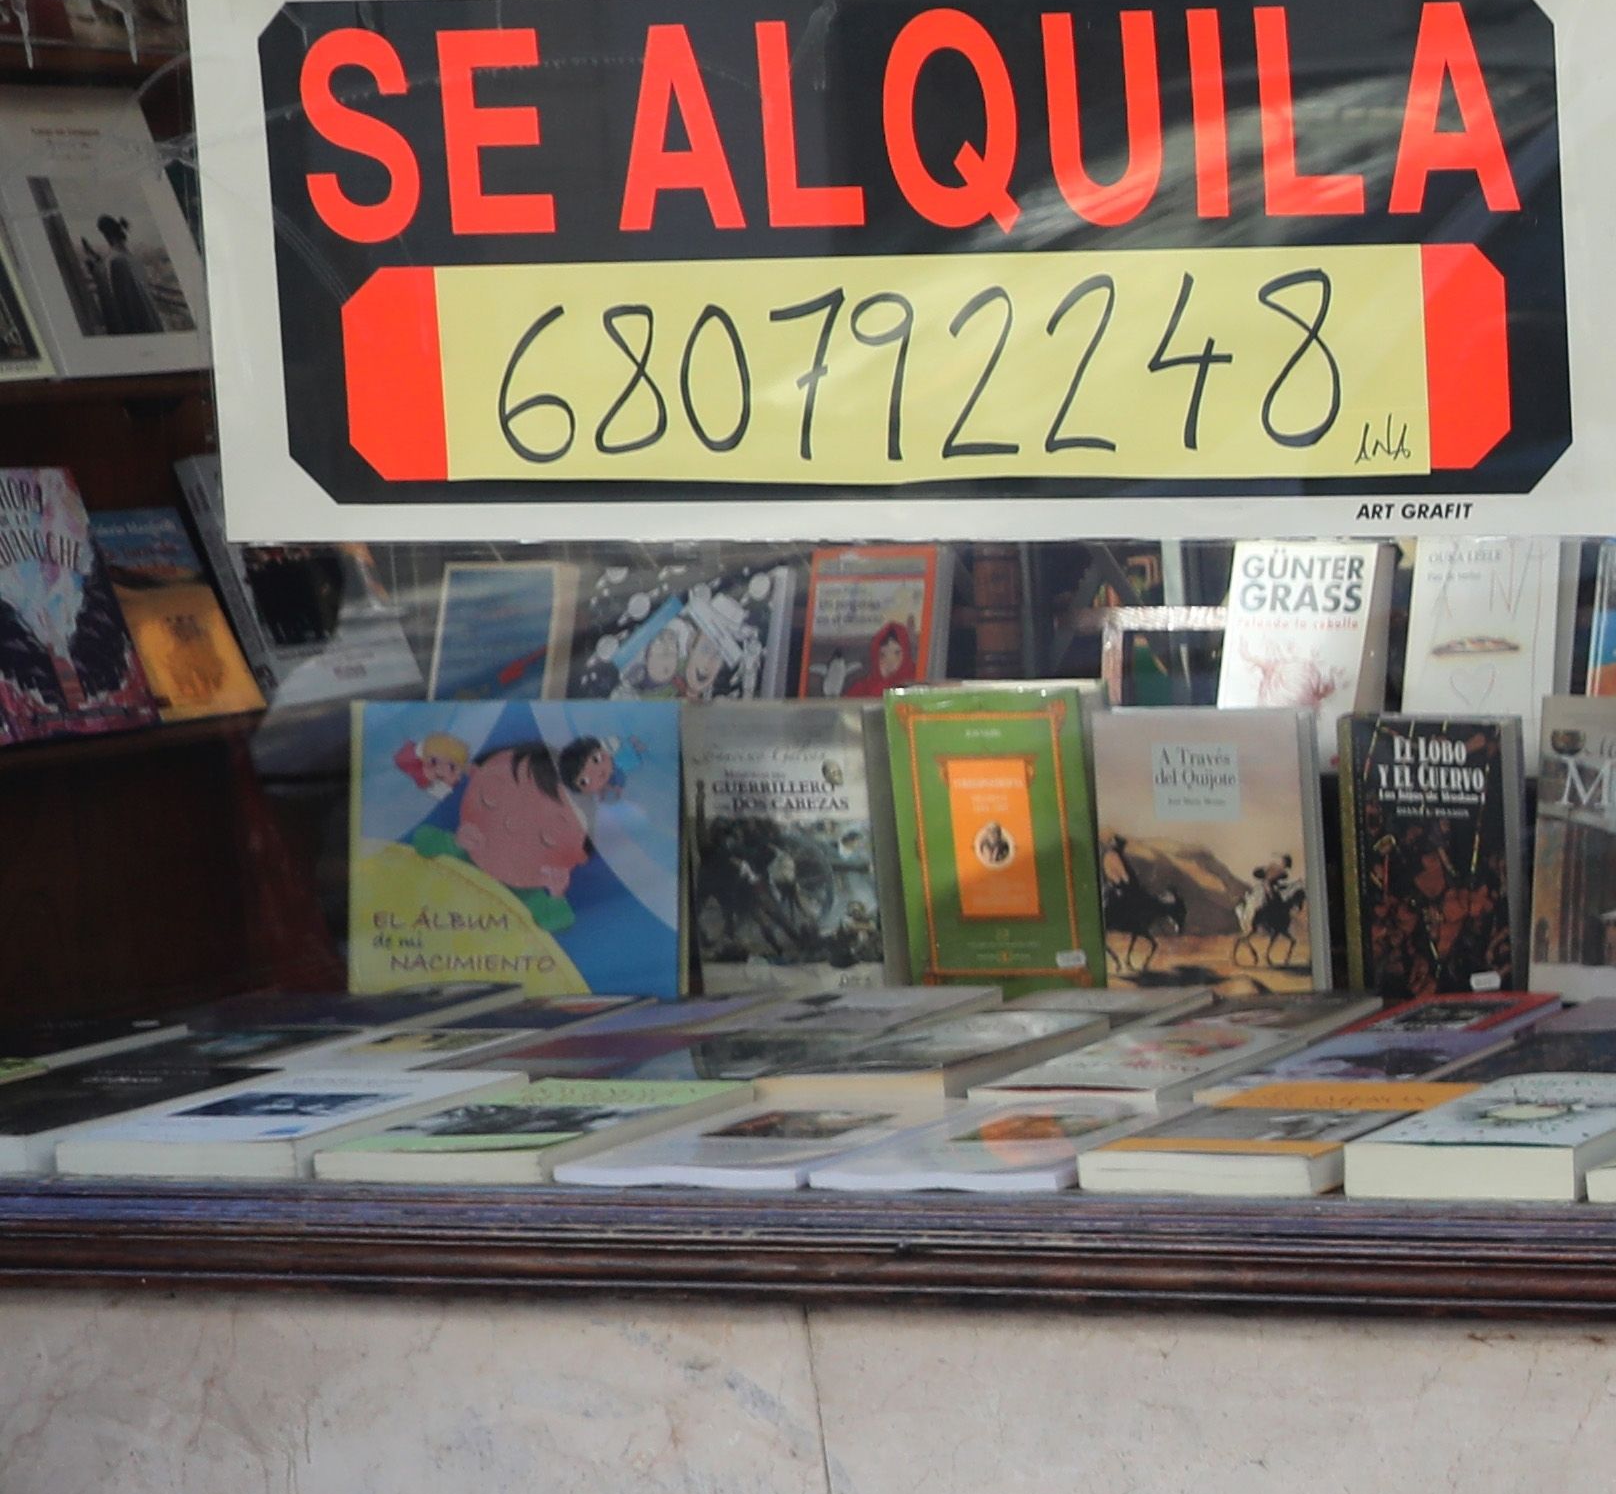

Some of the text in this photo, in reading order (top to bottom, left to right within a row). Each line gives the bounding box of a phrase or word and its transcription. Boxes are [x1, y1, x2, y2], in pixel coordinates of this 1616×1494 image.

[299, 0, 1522, 245] SE ALQUILA
[497, 267, 1347, 467] 680792248
[1356, 503, 1474, 520] ART GRAFIT
[1241, 546, 1364, 583] GÜNTER
[1240, 580, 1363, 614] GRASS
[1159, 746, 1231, 765] A Través
[1154, 768, 1237, 790] del Quijote
[1377, 764, 1388, 788] Y
[712, 780, 836, 795] GUERRILLERO
[732, 796, 850, 811] DOS CABEZAS
[372, 906, 509, 933] EL ÁLBUM
[372, 932, 424, 949] de mi
[389, 953, 557, 975] NACIMIENTO
